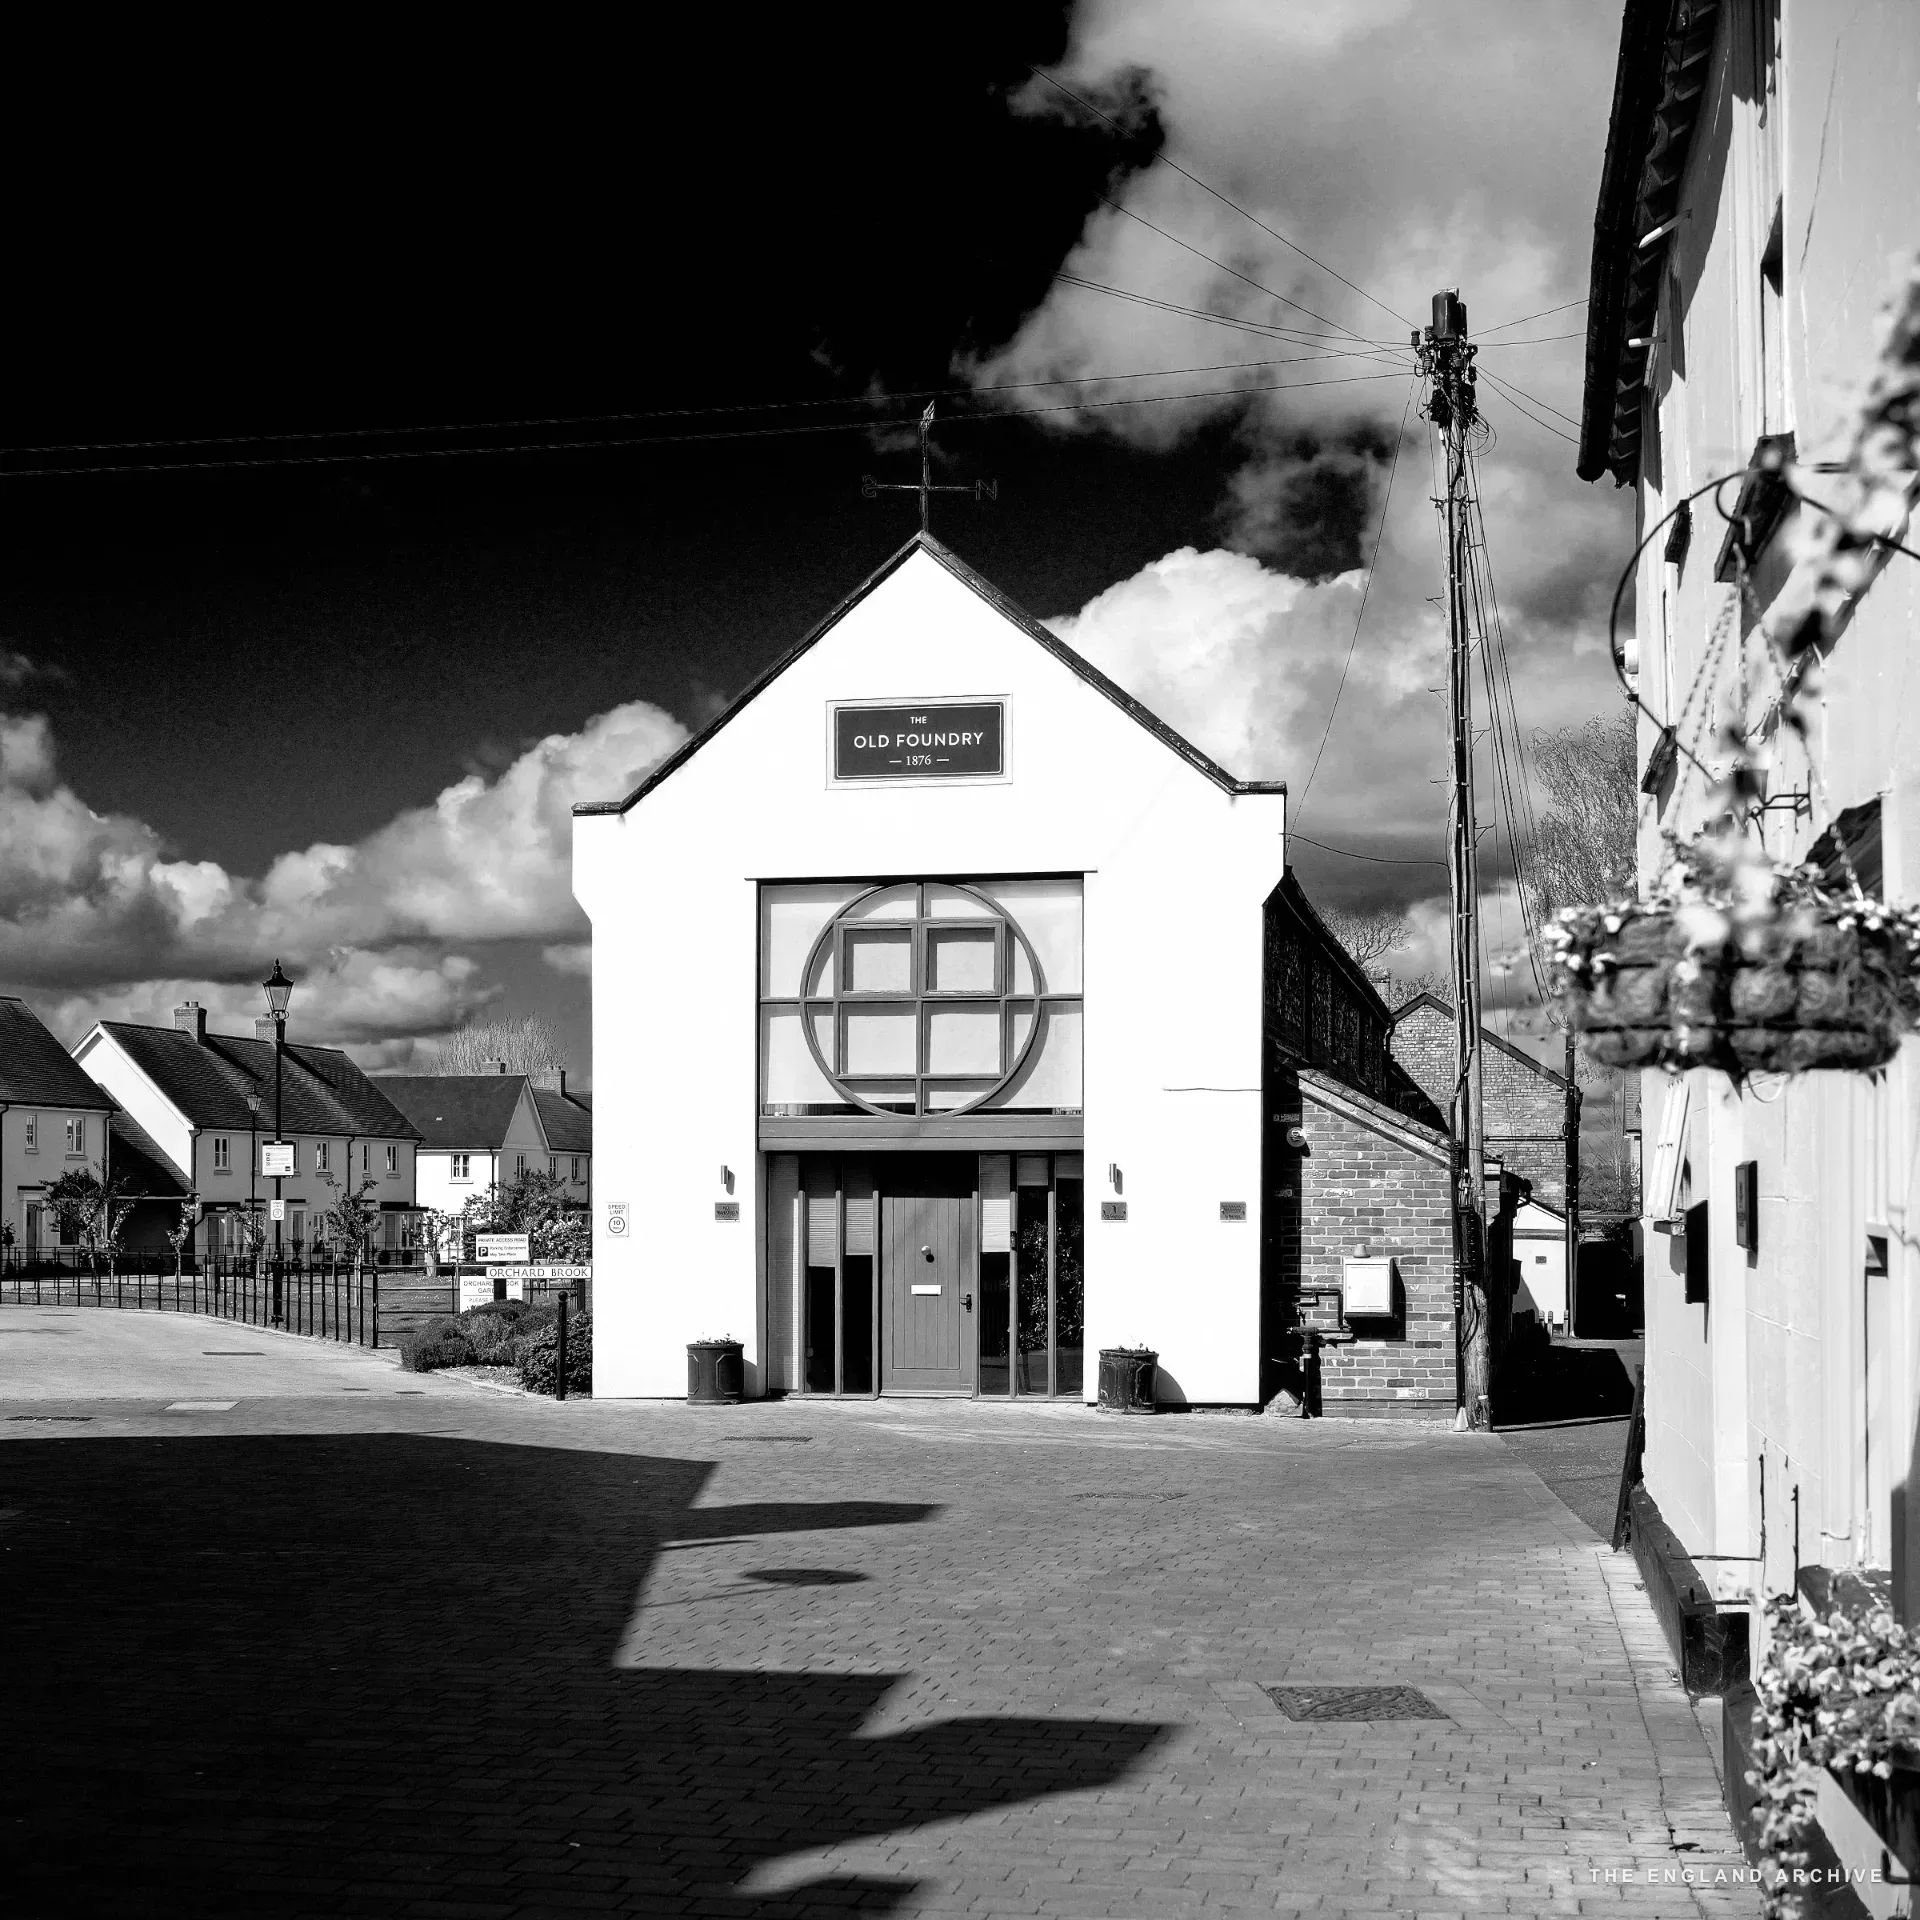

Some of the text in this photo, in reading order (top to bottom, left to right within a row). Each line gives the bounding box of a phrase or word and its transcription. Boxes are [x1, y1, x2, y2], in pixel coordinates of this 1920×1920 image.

[975, 479, 997, 500] N
[910, 716, 927, 724] THE
[854, 732, 983, 748] OLD FOUNDRY
[906, 755, 932, 766] 1876
[489, 1268, 588, 1277] ORCHARD BROOK
